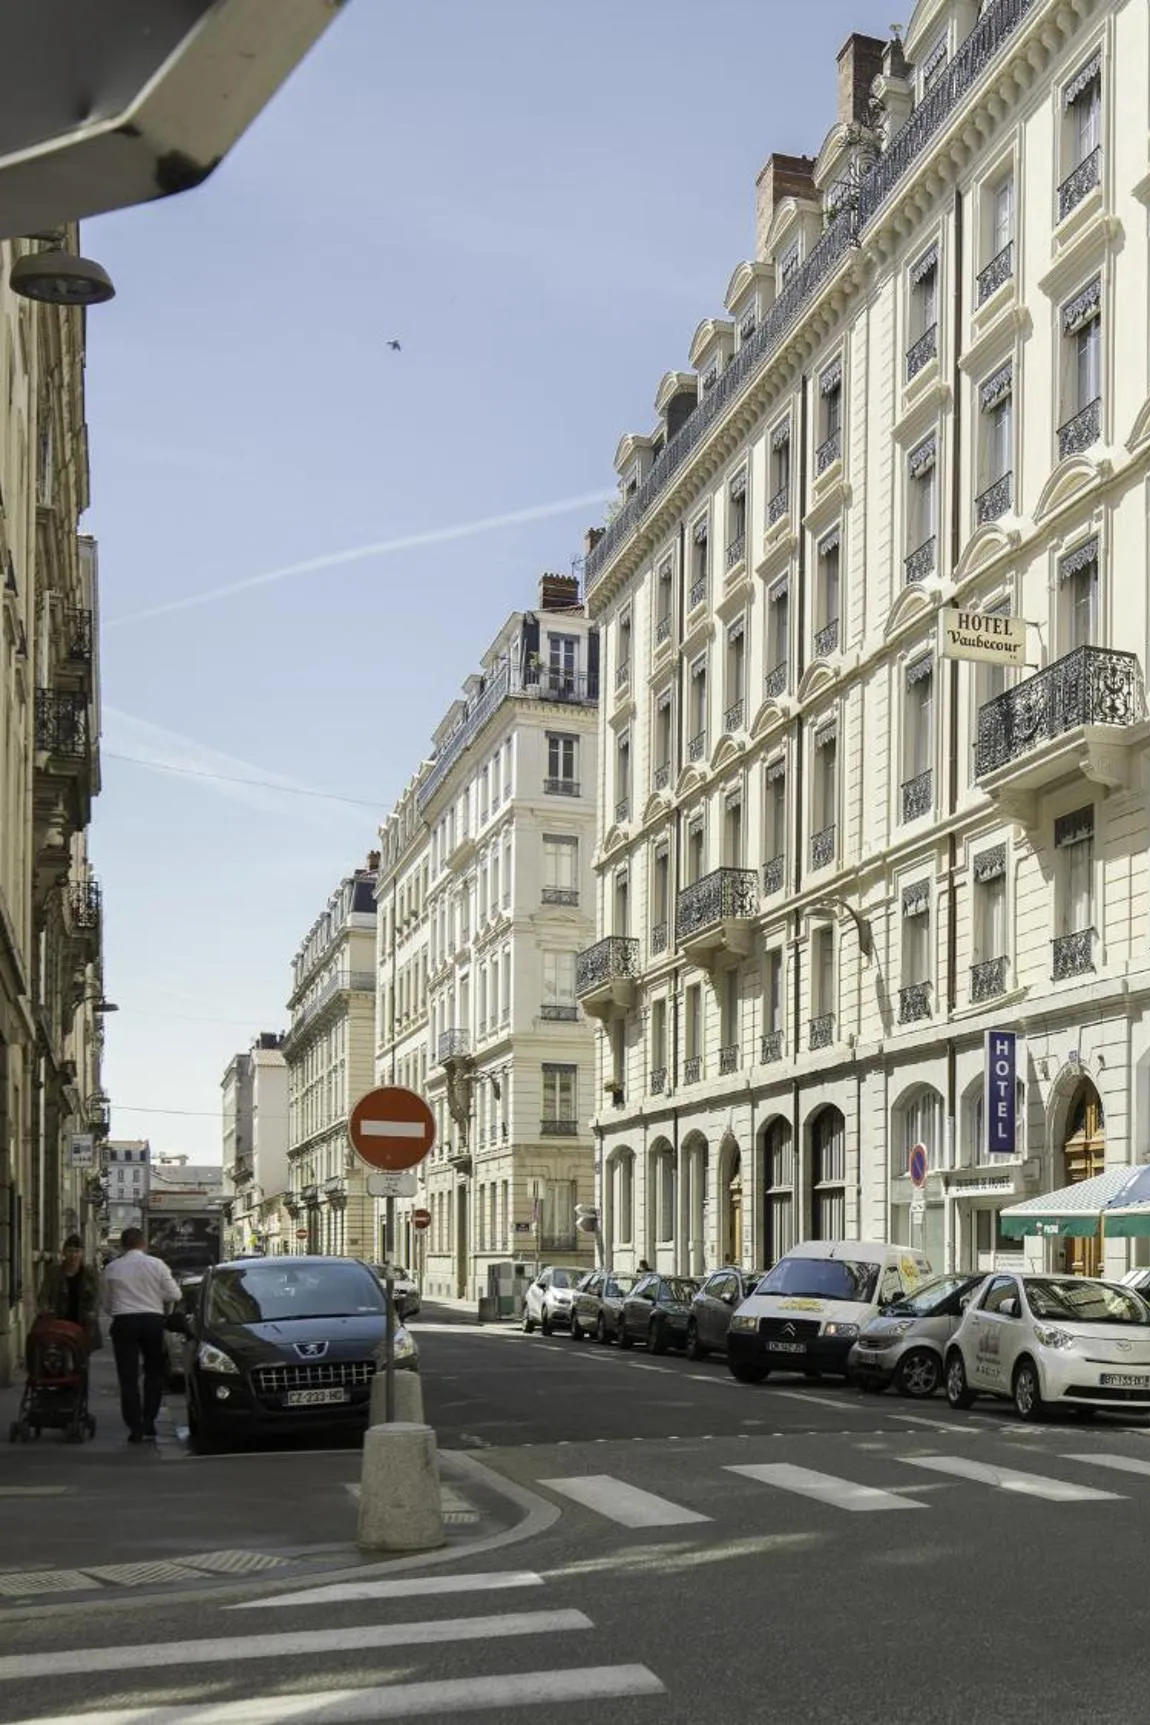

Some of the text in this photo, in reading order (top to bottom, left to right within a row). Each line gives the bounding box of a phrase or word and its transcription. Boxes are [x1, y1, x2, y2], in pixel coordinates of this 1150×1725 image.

[958, 613, 1013, 636] HOTEL
[947, 630, 1023, 652] Vaubecour
[996, 1039, 1010, 1138] HOTEL
